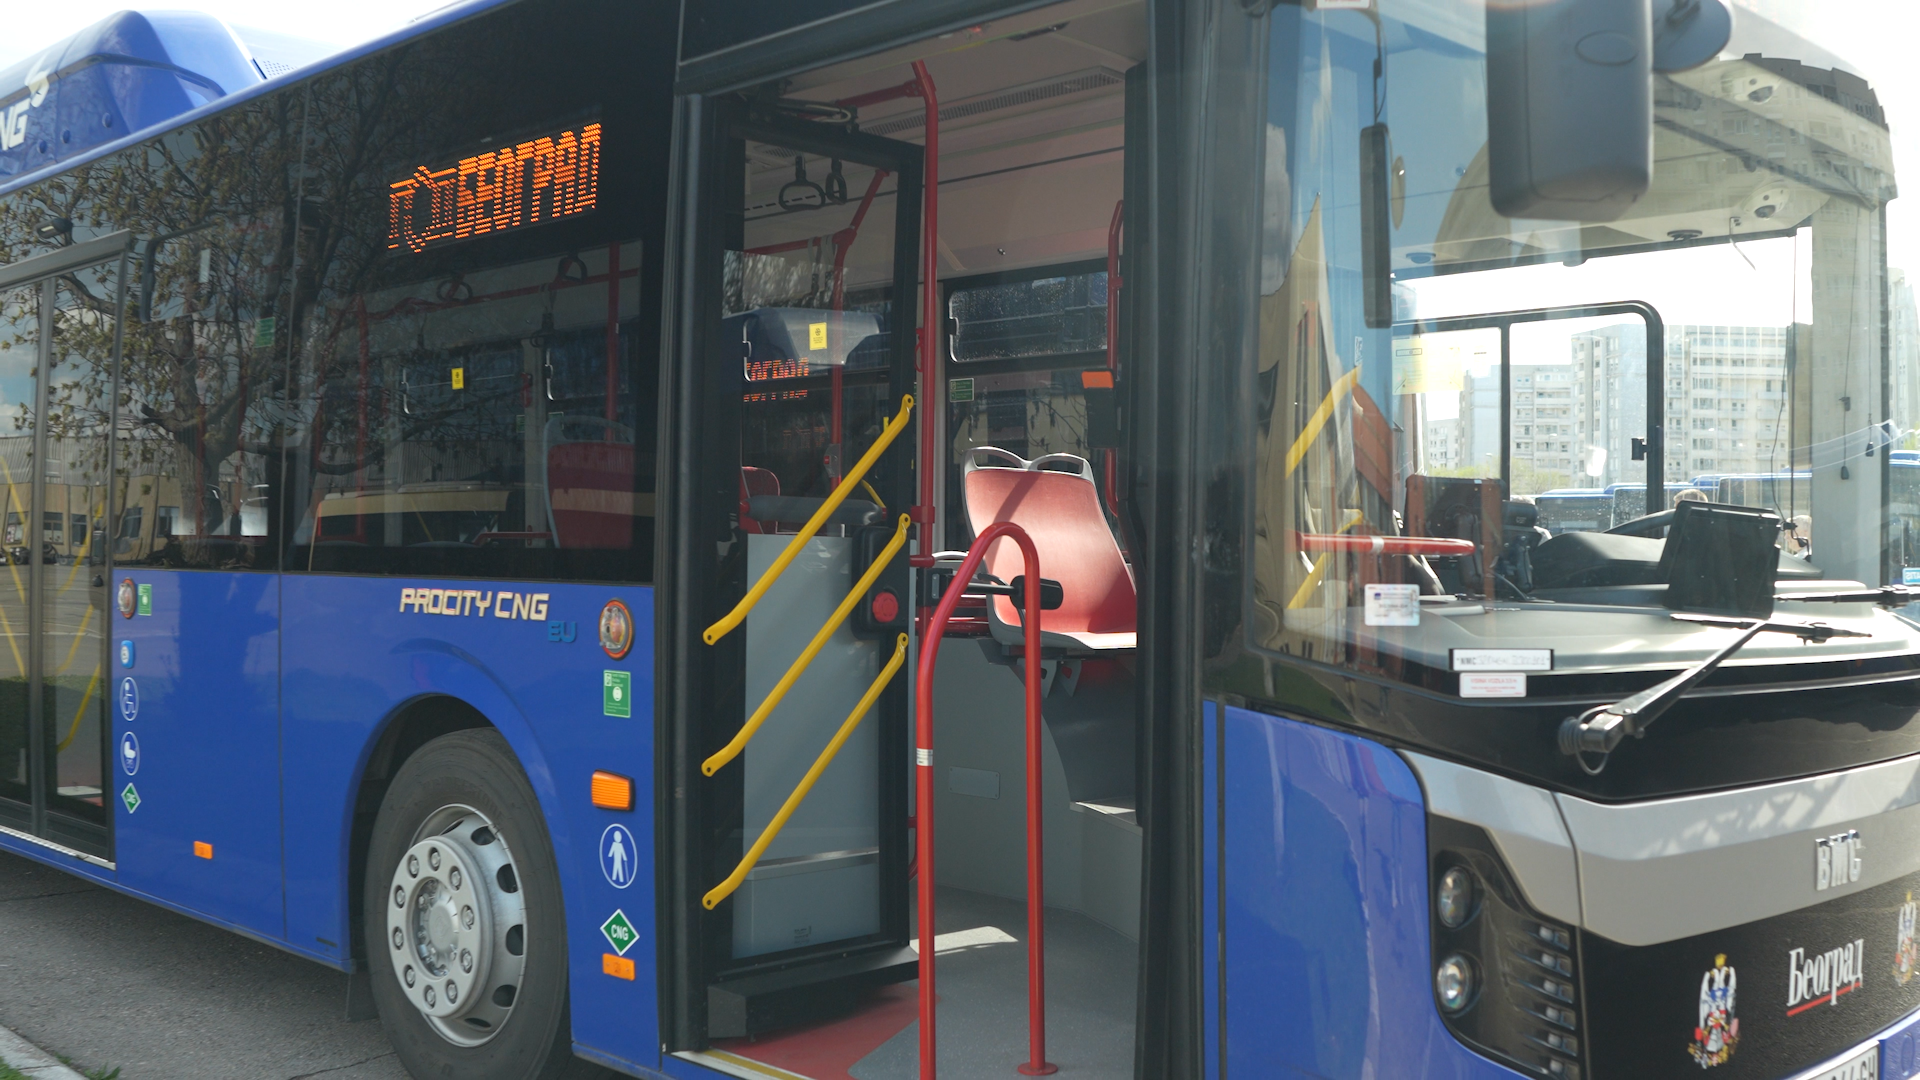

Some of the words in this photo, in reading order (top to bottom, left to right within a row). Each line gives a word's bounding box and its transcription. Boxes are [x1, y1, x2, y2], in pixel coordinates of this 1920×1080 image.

[455, 122, 602, 239] БЕОГРАД
[399, 587, 493, 618] PROCITY
[494, 591, 550, 621] CNG
[547, 620, 576, 643] EU
[610, 924, 629, 941] CNG
[1786, 938, 1864, 1007] Београд
